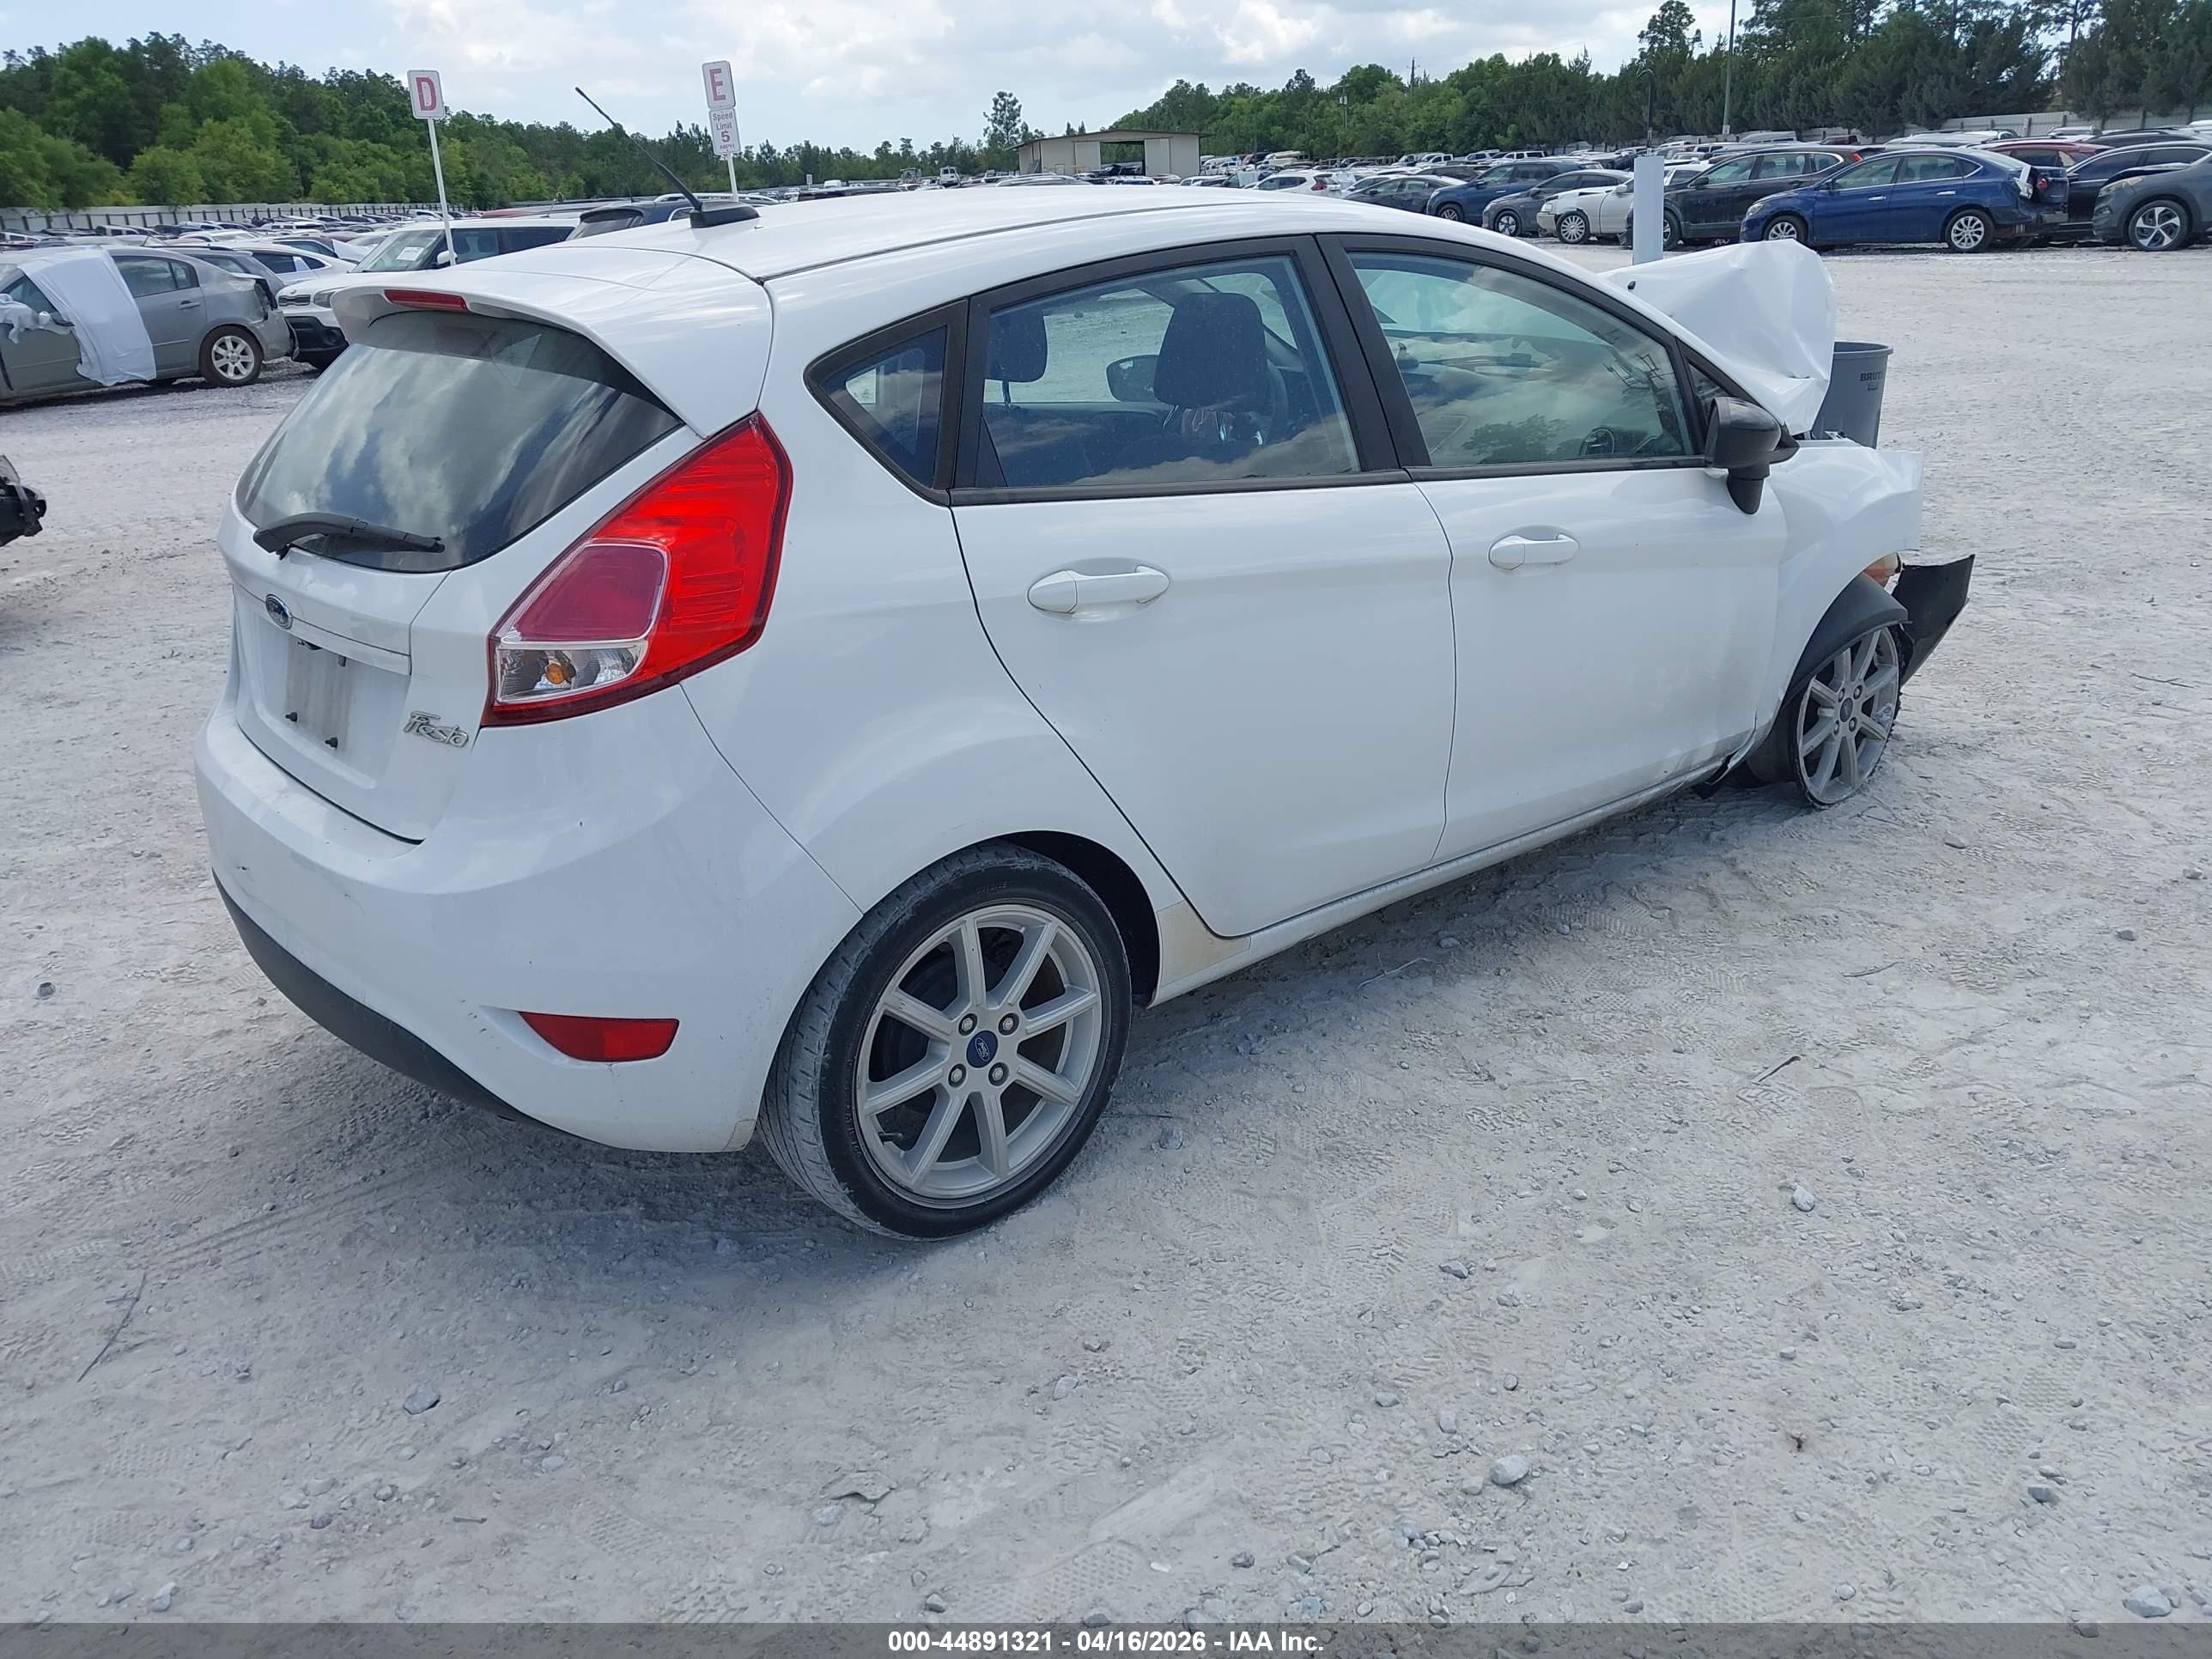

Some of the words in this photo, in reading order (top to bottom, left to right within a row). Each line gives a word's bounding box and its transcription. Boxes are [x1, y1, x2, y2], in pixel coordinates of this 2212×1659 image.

[416, 77, 437, 111] D
[709, 68, 726, 101] E
[713, 112, 733, 122] Speed
[721, 131, 730, 143] 5
